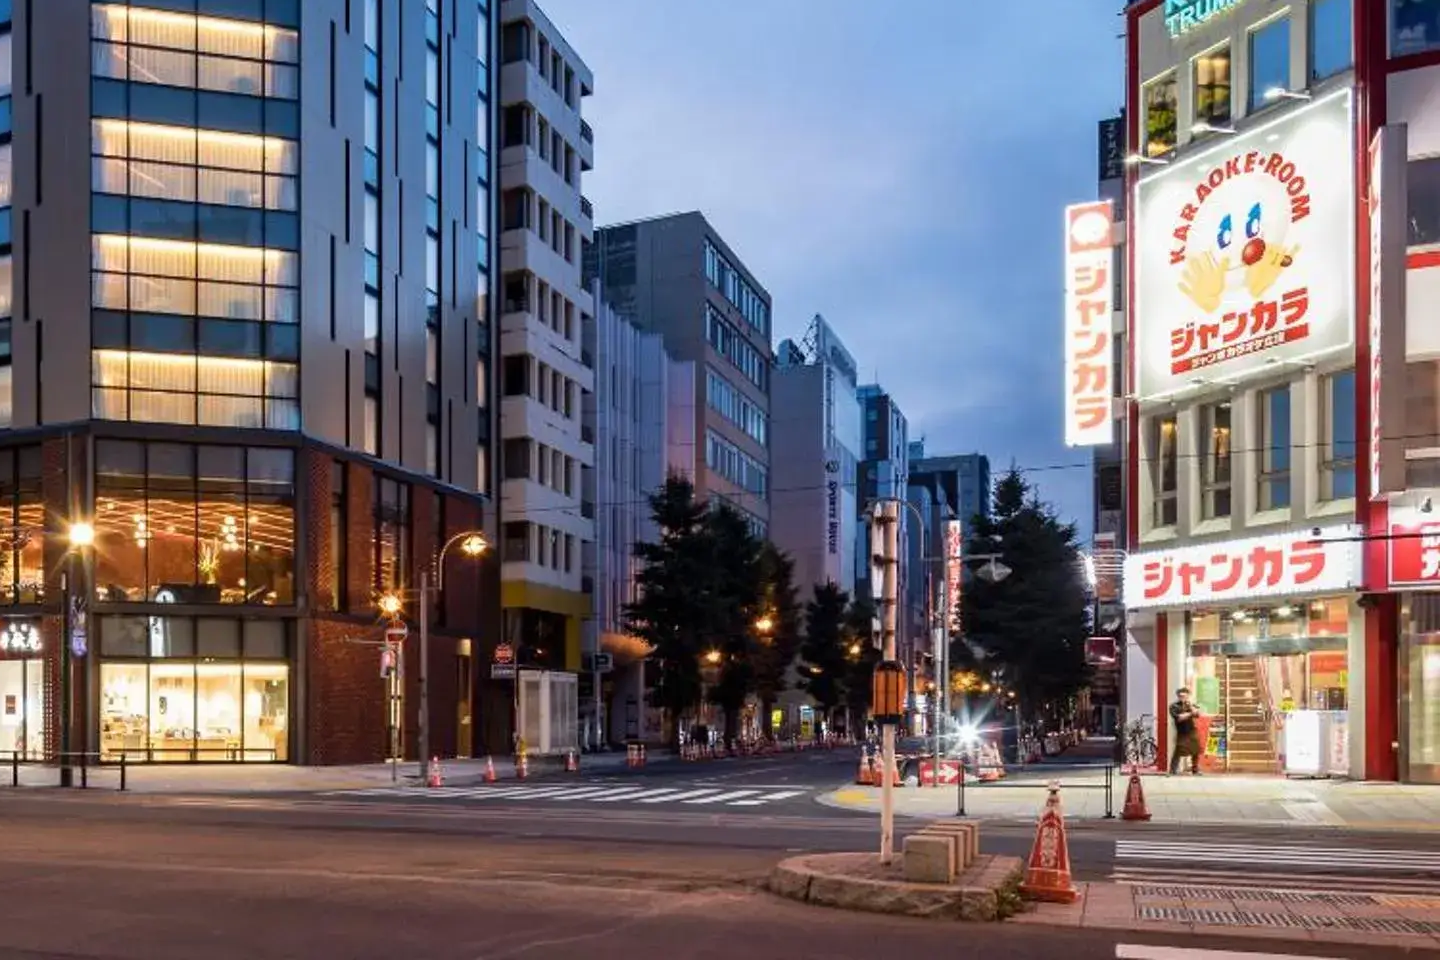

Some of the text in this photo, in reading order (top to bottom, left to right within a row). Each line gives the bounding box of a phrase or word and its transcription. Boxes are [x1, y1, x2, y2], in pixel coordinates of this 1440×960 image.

[1073, 260, 1108, 431] ジャンカラ
[1171, 287, 1309, 357] ジャンカラ
[1143, 541, 1326, 599] ジャンカラ
